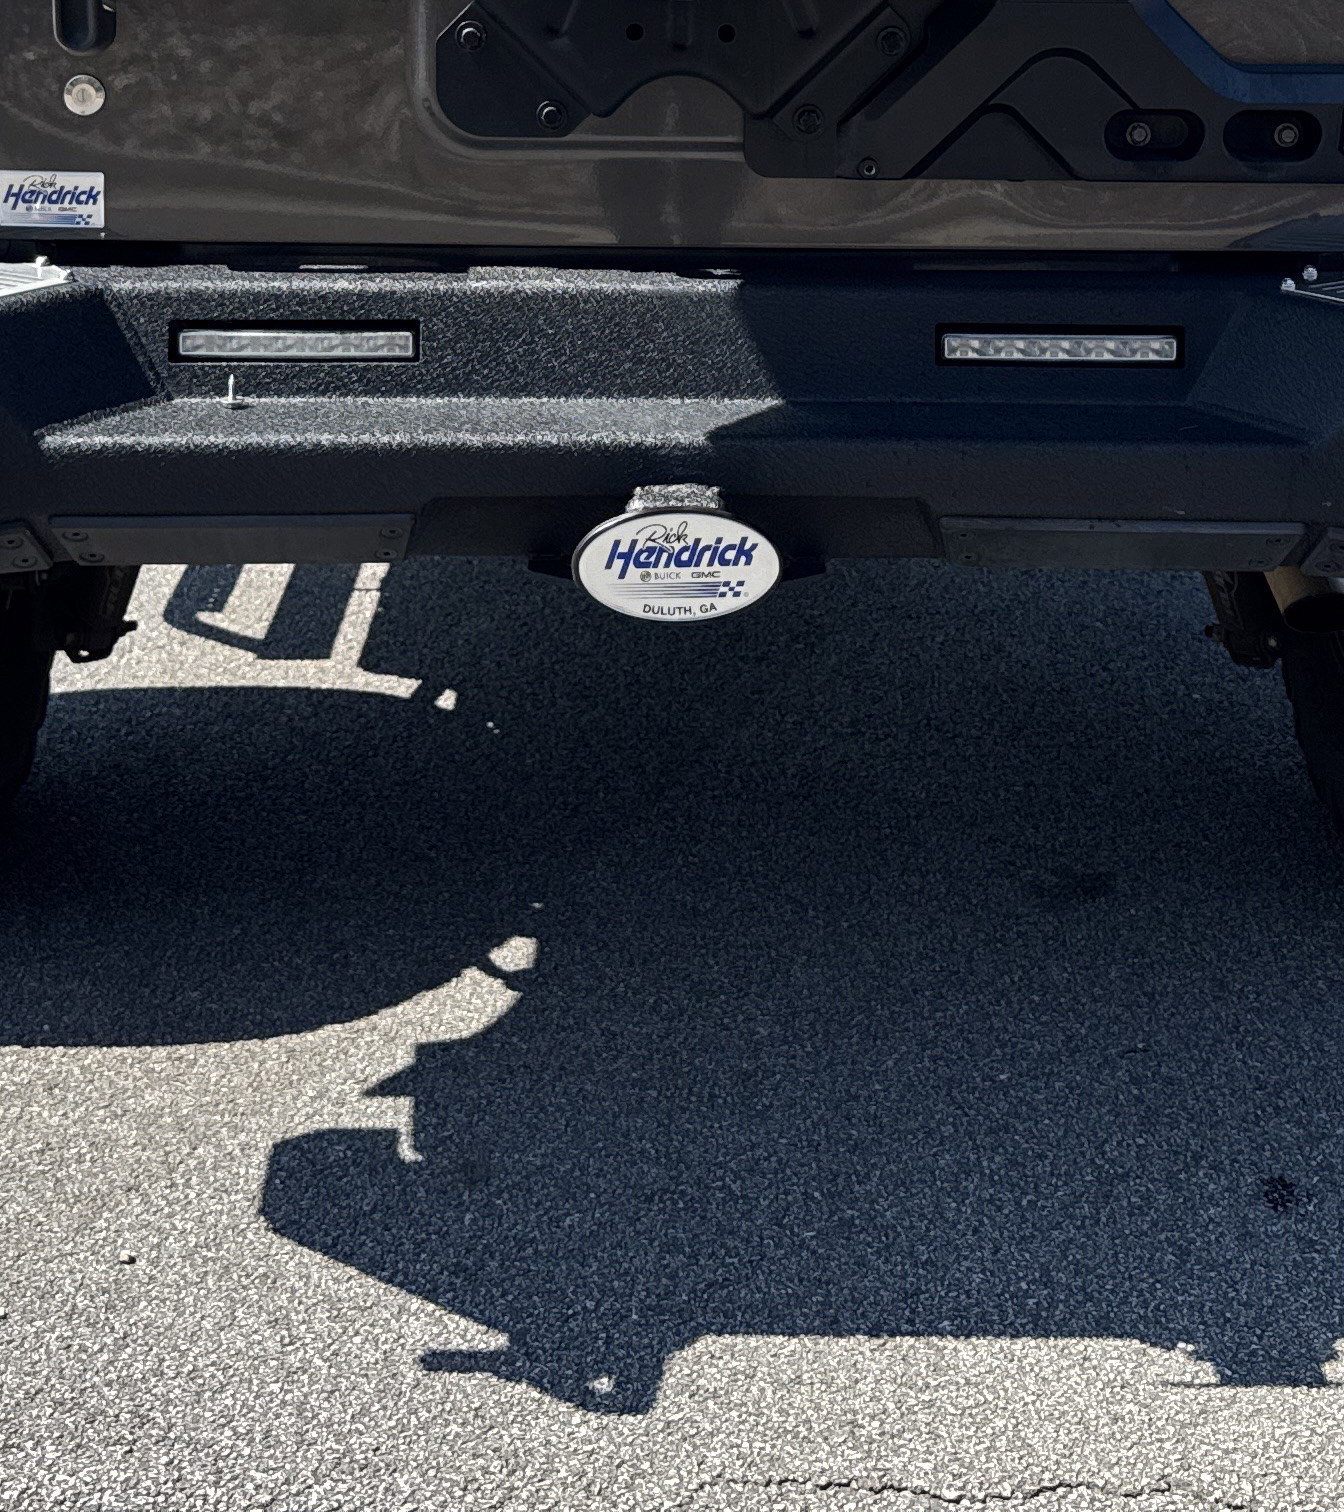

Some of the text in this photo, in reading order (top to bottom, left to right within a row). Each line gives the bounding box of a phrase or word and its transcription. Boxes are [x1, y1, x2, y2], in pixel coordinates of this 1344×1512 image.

[2, 183, 102, 211] Hendrick
[635, 520, 689, 549] Rick
[604, 535, 759, 580] Hendrick
[654, 570, 722, 580] BUICK GMC
[642, 603, 719, 617] DULUTH, GA
